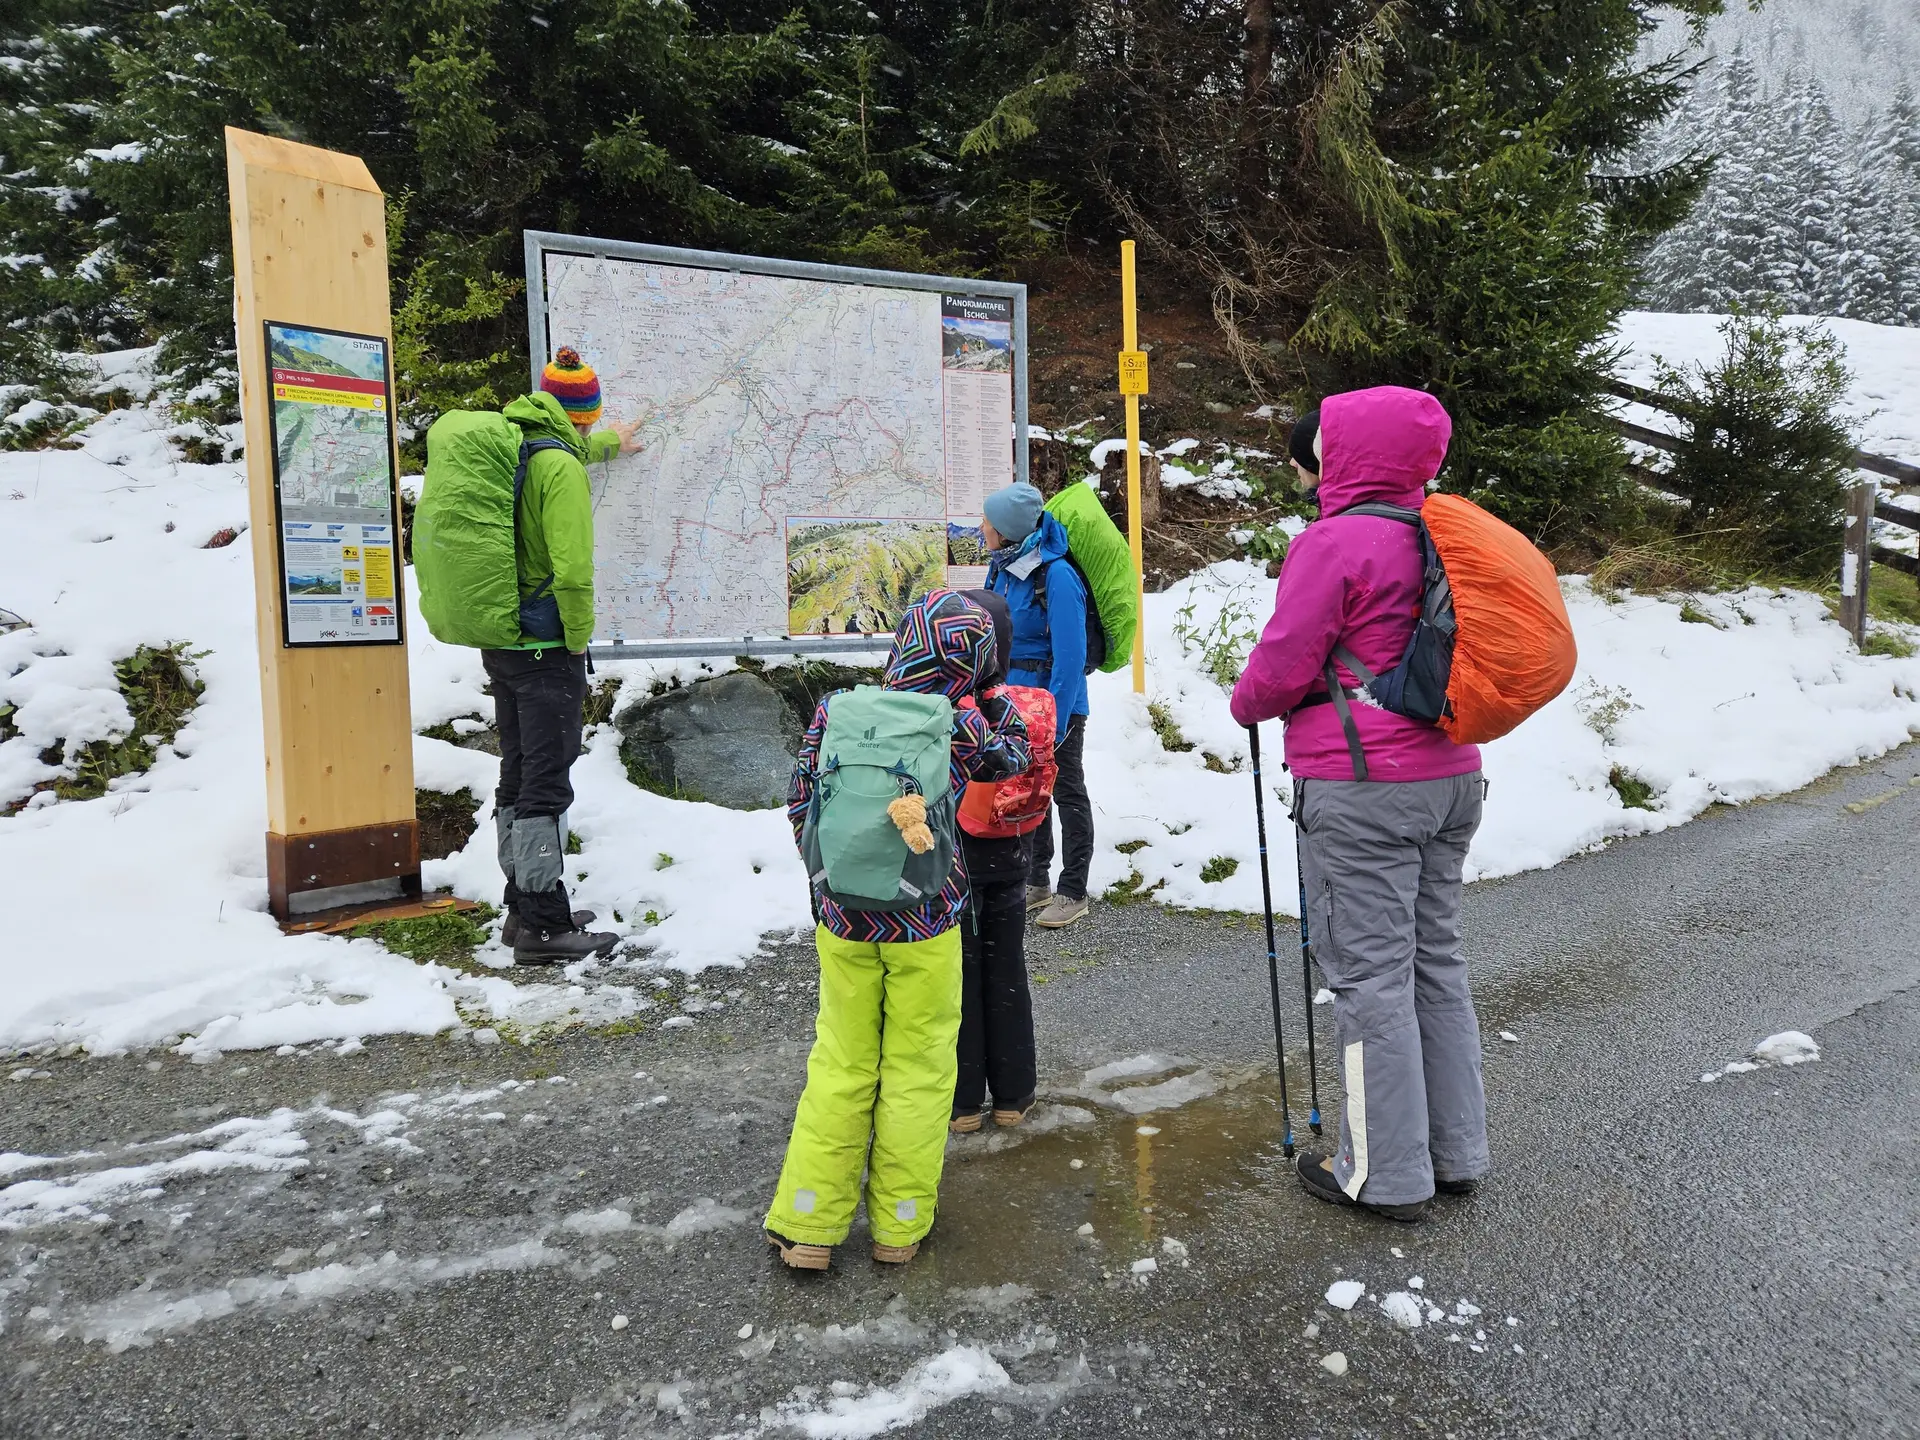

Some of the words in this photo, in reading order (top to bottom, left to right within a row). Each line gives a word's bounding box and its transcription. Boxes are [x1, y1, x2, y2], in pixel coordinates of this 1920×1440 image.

[946, 296, 1006, 311] PANORAMATAFEL
[964, 309, 989, 319] ISCHGL
[352, 341, 380, 351] START
[857, 740, 880, 749] deuter
